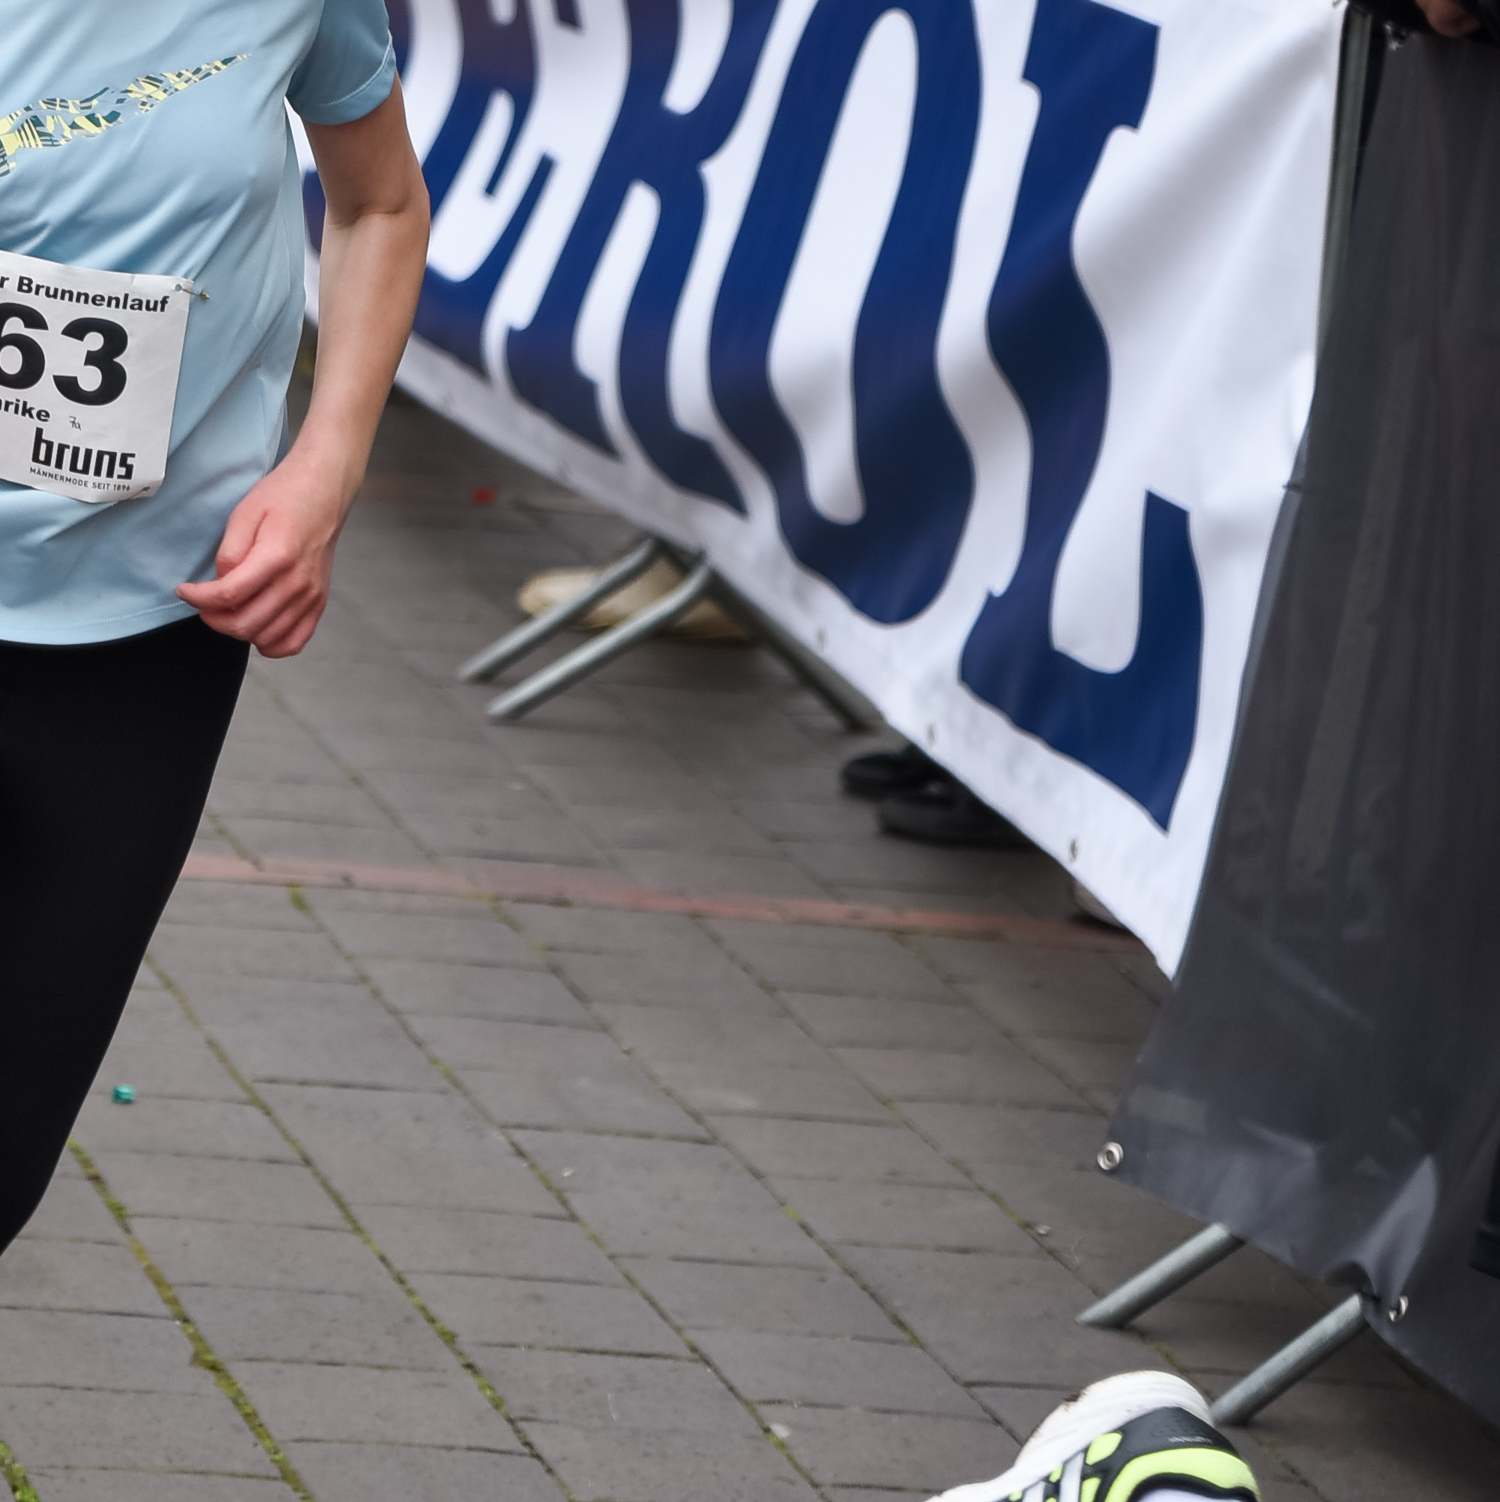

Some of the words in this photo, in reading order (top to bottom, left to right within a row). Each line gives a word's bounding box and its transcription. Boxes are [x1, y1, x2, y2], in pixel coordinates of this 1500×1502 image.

[16, 274, 170, 314] Brunnenlauf
[30, 426, 137, 481] bruns
[29, 466, 89, 489] MÄNNERMODE
[91, 481, 111, 491] SEIT
[112, 483, 131, 492] 1896
